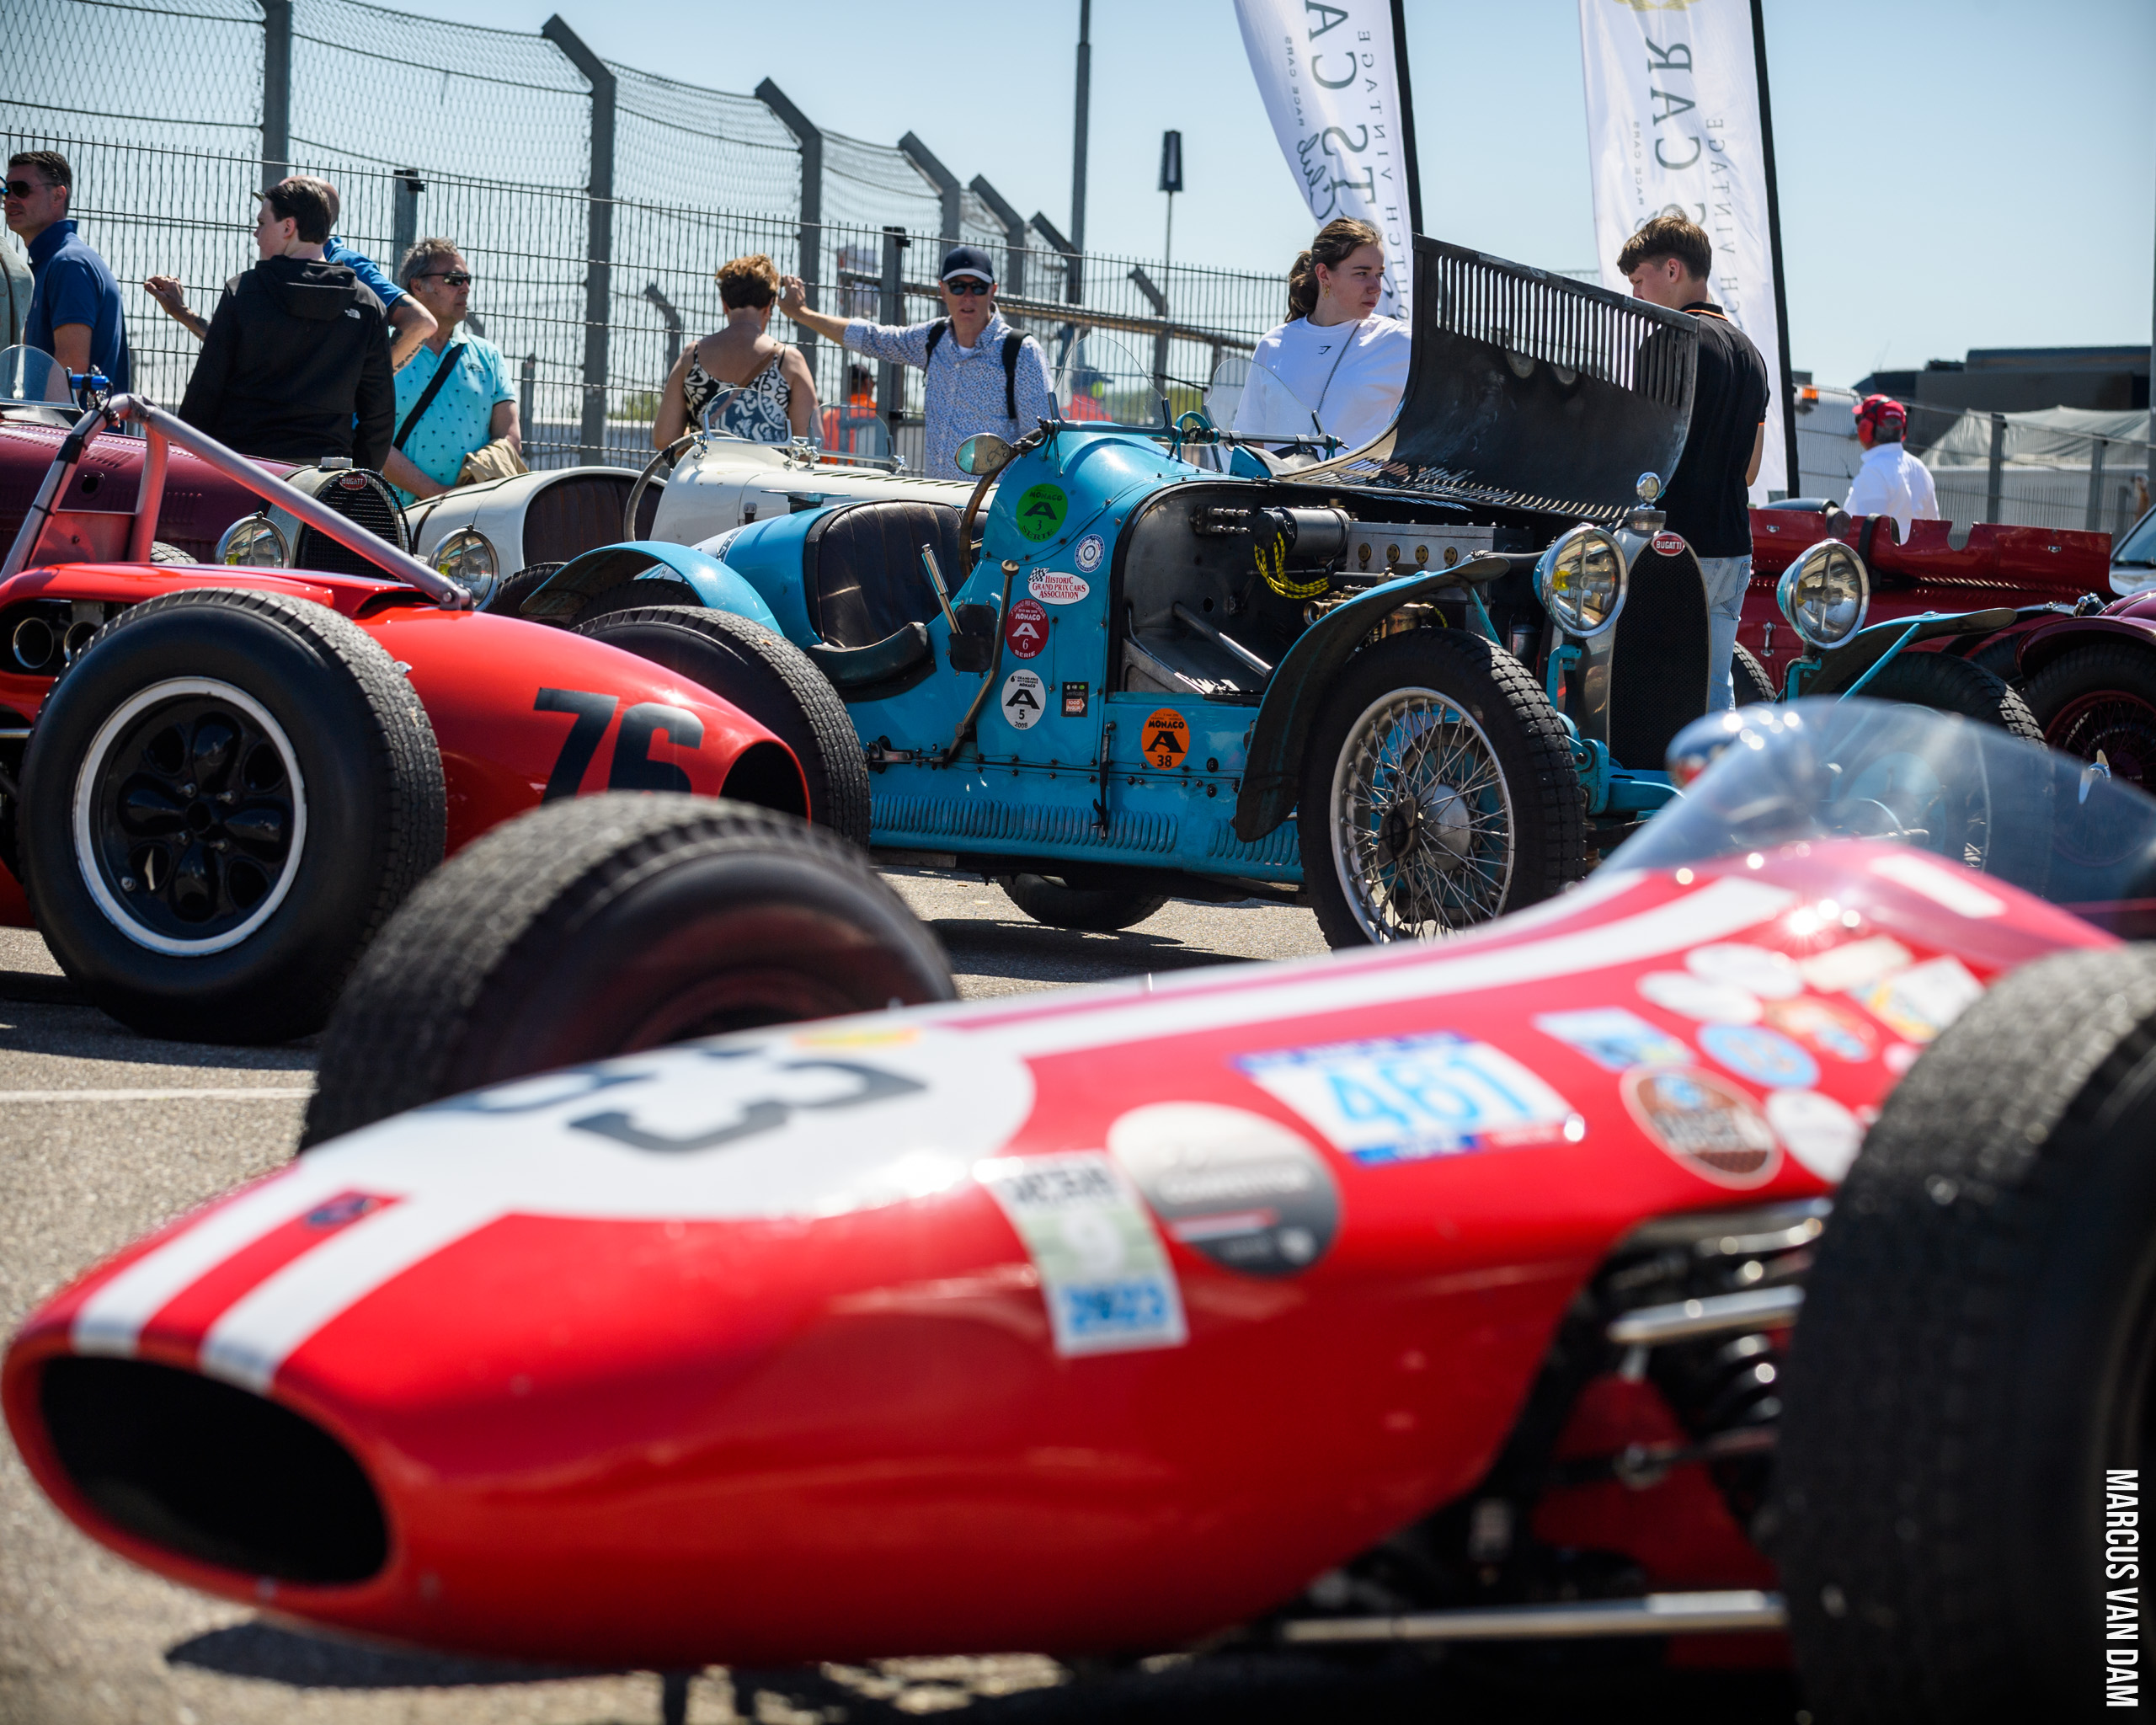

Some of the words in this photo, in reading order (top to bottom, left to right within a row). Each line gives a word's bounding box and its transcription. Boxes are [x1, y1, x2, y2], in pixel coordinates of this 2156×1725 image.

[1029, 491, 1063, 502] MONACO
[1023, 501, 1058, 520] A
[1036, 520, 1042, 531] 3
[1022, 525, 1054, 541] SERIE
[1656, 541, 1682, 550] BUGATTI
[1045, 575, 1074, 584] HISTORIC
[1032, 582, 1054, 590] GRAND
[1069, 584, 1086, 592] CARS
[1038, 590, 1079, 600] ASSOCIATION
[1012, 622, 1040, 638] A
[1022, 638, 1029, 649] 6
[1015, 649, 1036, 658] SERIE
[1006, 689, 1040, 710] A
[1019, 709, 1025, 719] 5
[1148, 720, 1184, 729] MONACO
[533, 686, 705, 806] 76
[1145, 730, 1186, 754] A
[1157, 755, 1172, 767] 38
